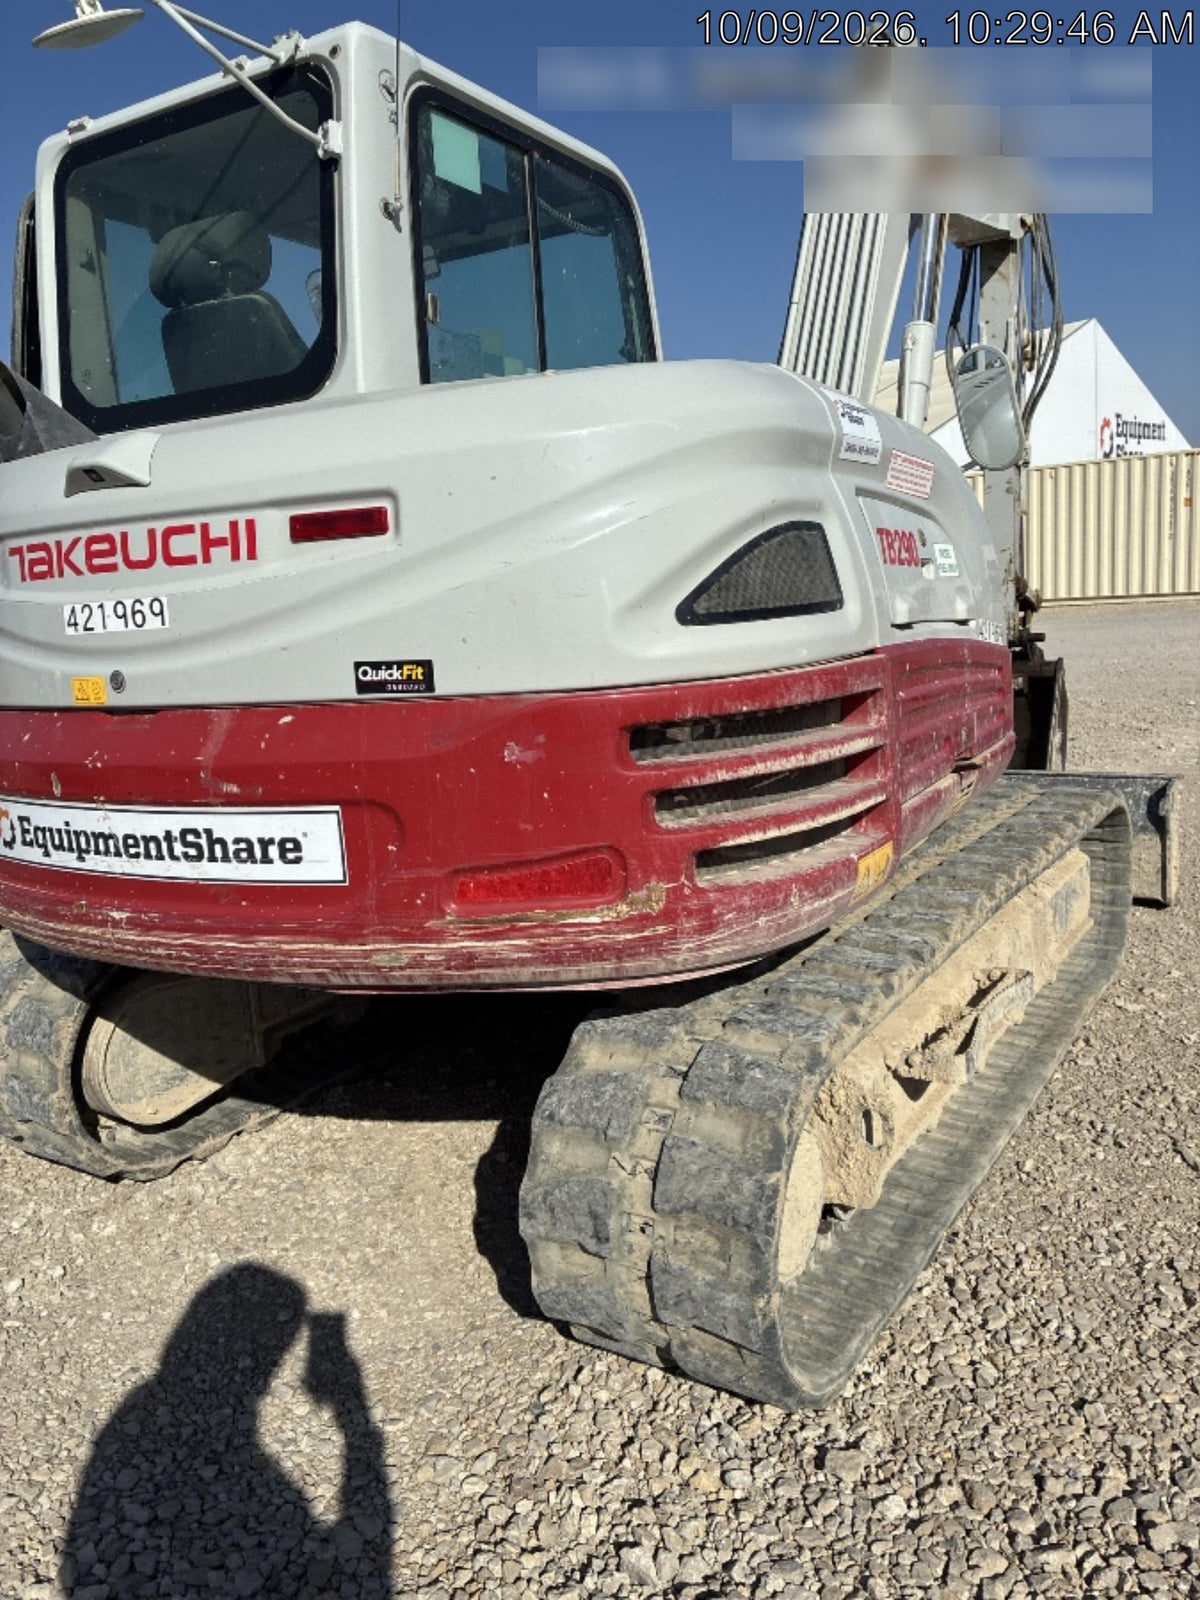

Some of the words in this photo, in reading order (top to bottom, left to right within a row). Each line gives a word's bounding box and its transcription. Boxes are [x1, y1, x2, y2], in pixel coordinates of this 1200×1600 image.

[1115, 412, 1166, 445] Equipment
[876, 527, 920, 568] TB290
[67, 597, 165, 632] 421969
[17, 815, 304, 863] EquipmentShare
